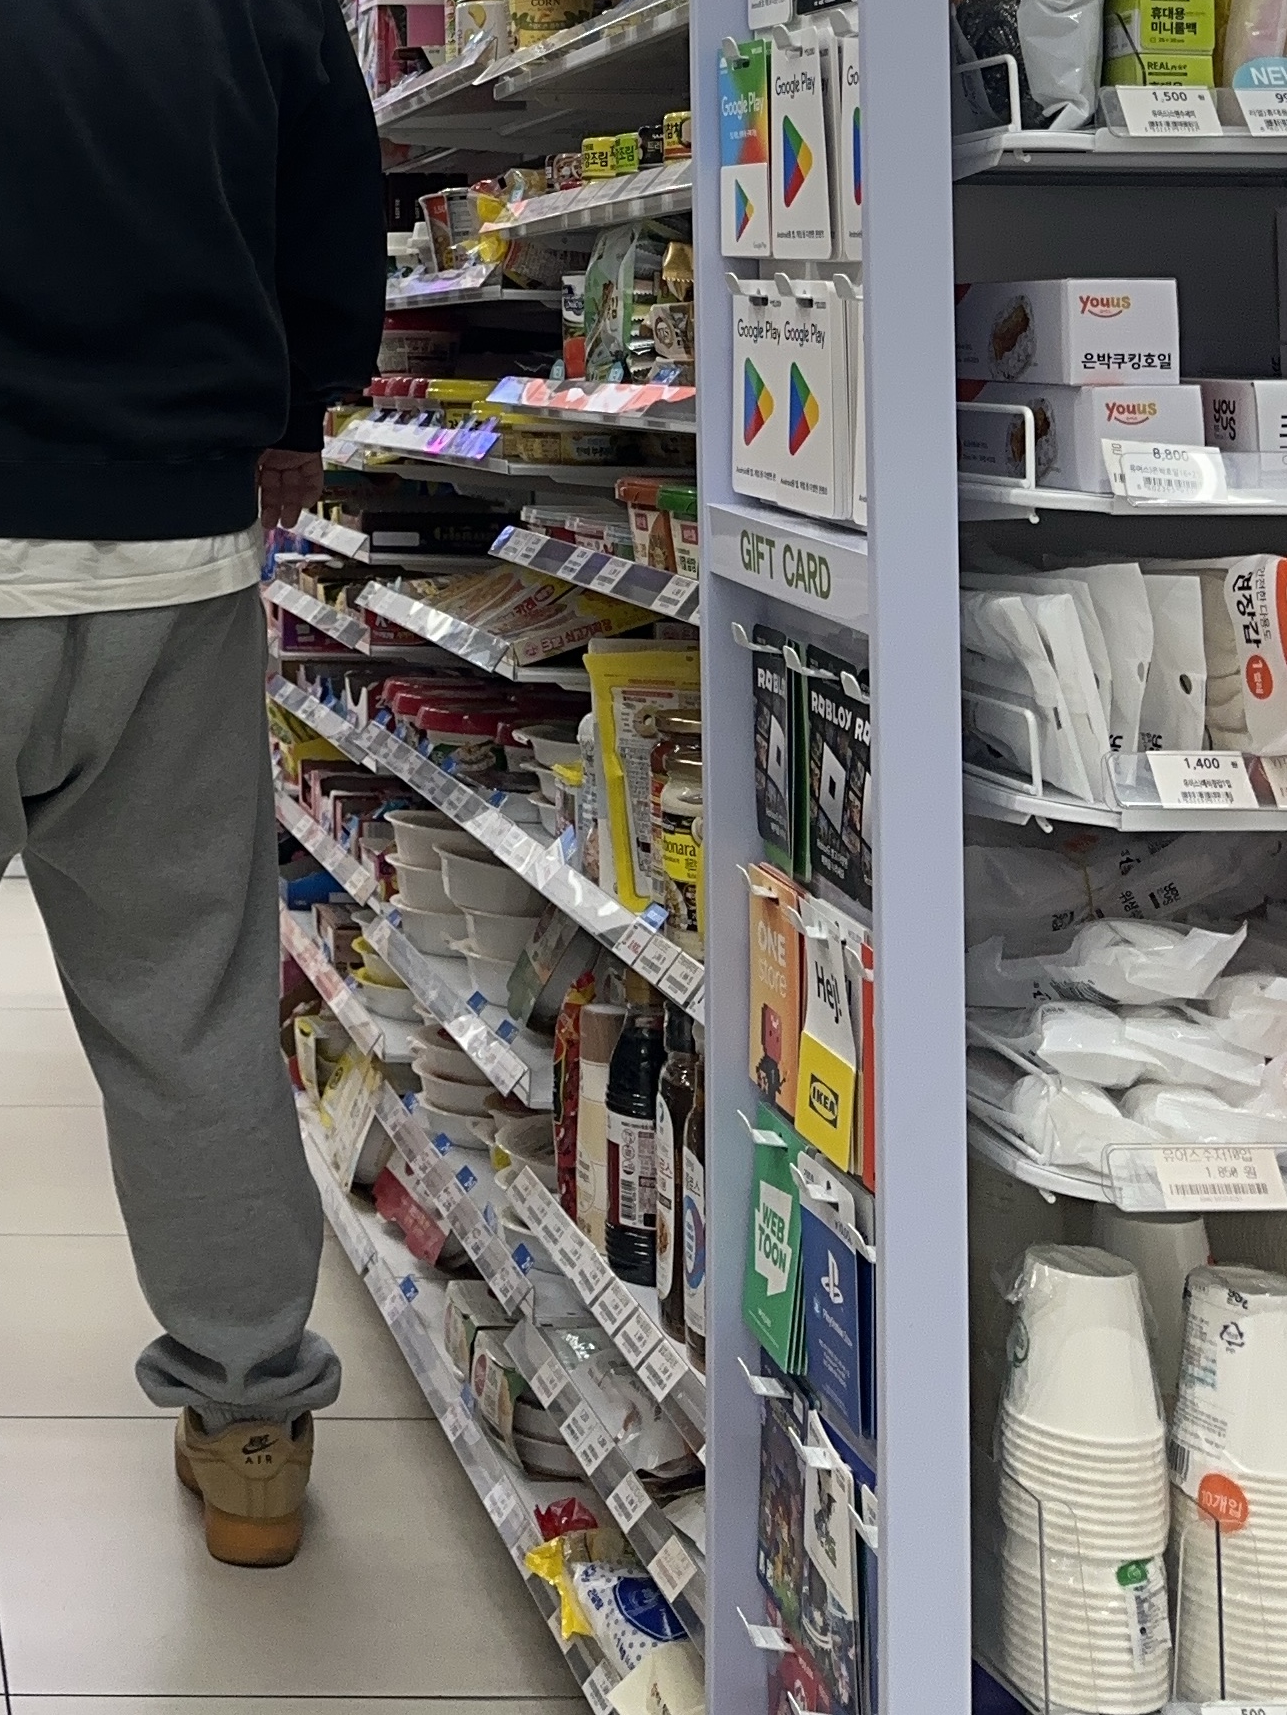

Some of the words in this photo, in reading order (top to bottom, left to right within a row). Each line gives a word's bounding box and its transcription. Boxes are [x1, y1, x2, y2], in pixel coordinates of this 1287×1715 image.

[1151, 7, 1185, 20] 휴대용
[1151, 22, 1197, 35] 미니롤백
[1147, 62, 1171, 70] REAL
[775, 75, 800, 99] Google
[801, 72, 816, 95] Play
[1152, 92, 1188, 103] 1,500
[722, 93, 747, 120] Google
[748, 91, 764, 114] Play
[1079, 295, 1131, 315] youus
[737, 318, 764, 344] Google
[765, 322, 781, 345] Play
[784, 320, 809, 347] Google
[810, 324, 826, 348] Play
[1081, 352, 1172, 370] 은박쿠킹호일
[1105, 402, 1158, 422] youus
[740, 528, 776, 580] GIFT
[783, 543, 831, 600] CARD
[757, 667, 786, 696] ROBL
[811, 690, 852, 731] ROBLOX
[1184, 758, 1220, 770] 1,400
[757, 920, 786, 968] ONE
[758, 957, 787, 998] store
[815, 961, 843, 1024] Hej!
[812, 1085, 836, 1117] IKEA
[763, 1203, 785, 1241] WEB
[758, 1223, 787, 1274] TOON
[245, 1455, 272, 1464] AIR
